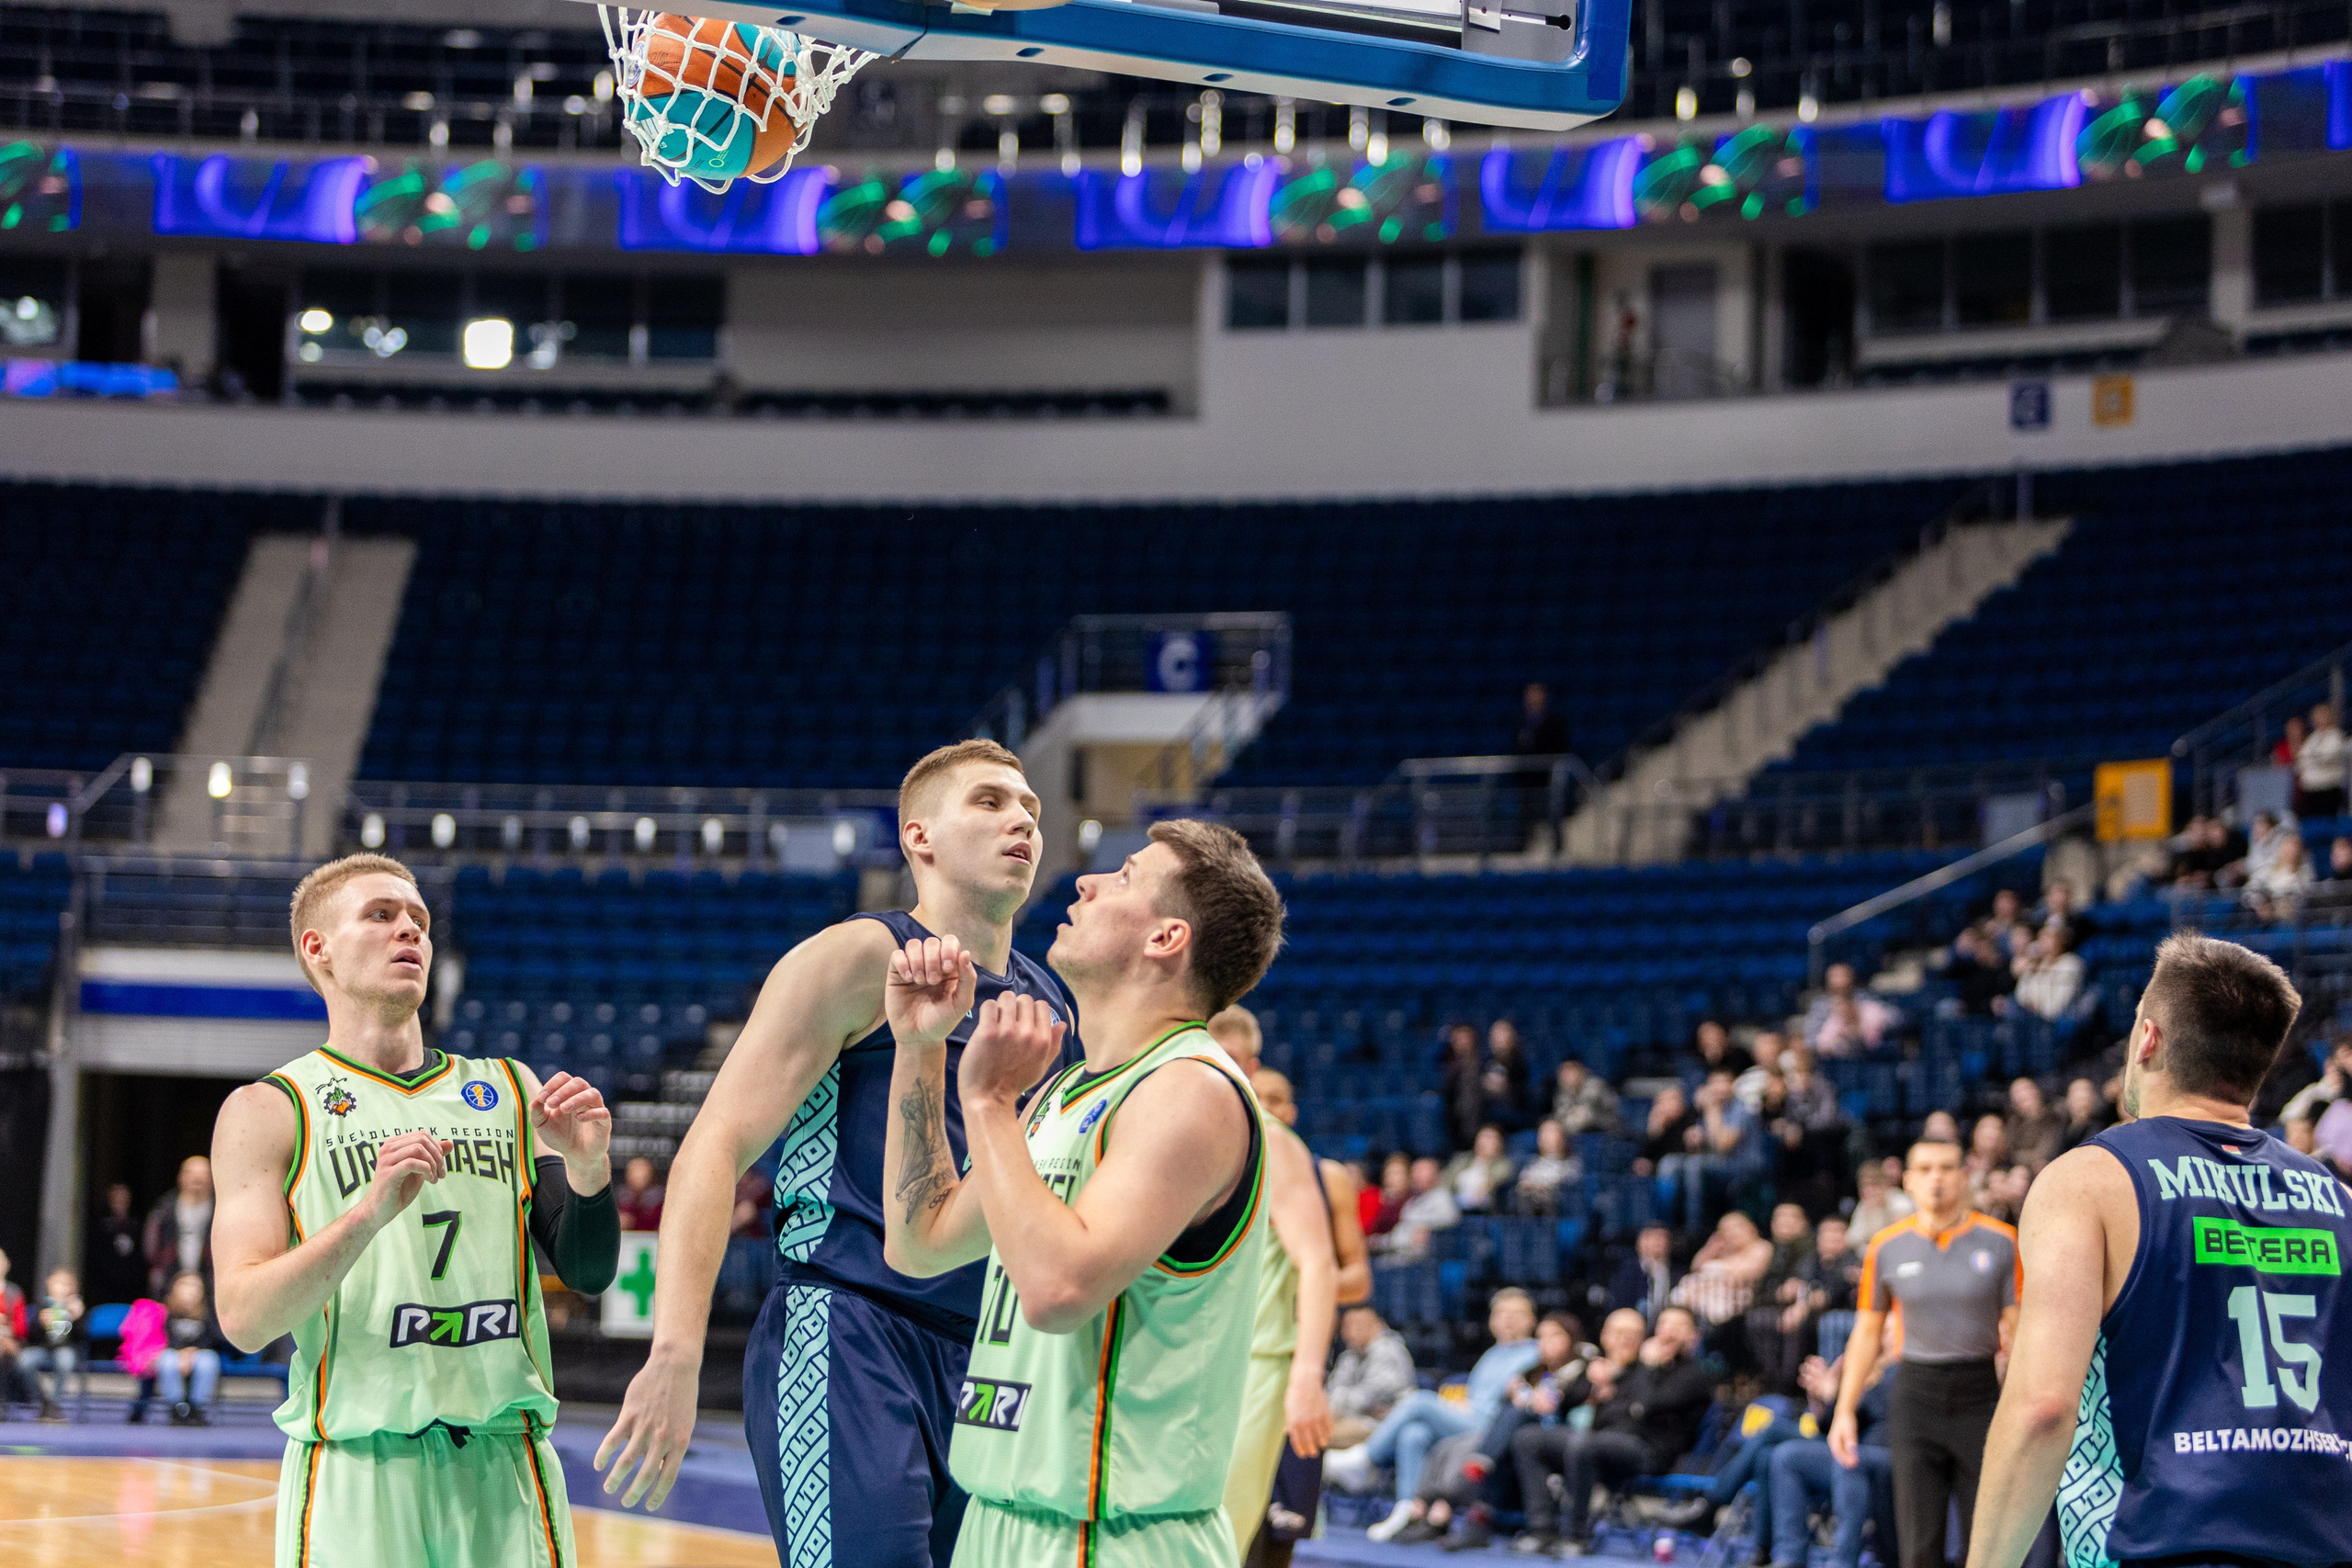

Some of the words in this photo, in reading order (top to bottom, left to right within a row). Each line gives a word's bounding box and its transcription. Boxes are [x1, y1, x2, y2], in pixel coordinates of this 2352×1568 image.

[326, 1127, 438, 1147] SVEDLOK
[451, 1127, 514, 1139] REGION
[328, 1138, 514, 1201] URASH
[2148, 1155, 2345, 1219] MIKULSKI
[423, 1210, 462, 1281] 7
[2203, 1227, 2331, 1265] BETERA
[396, 1303, 518, 1343] PARI
[2227, 1285, 2323, 1413] 15
